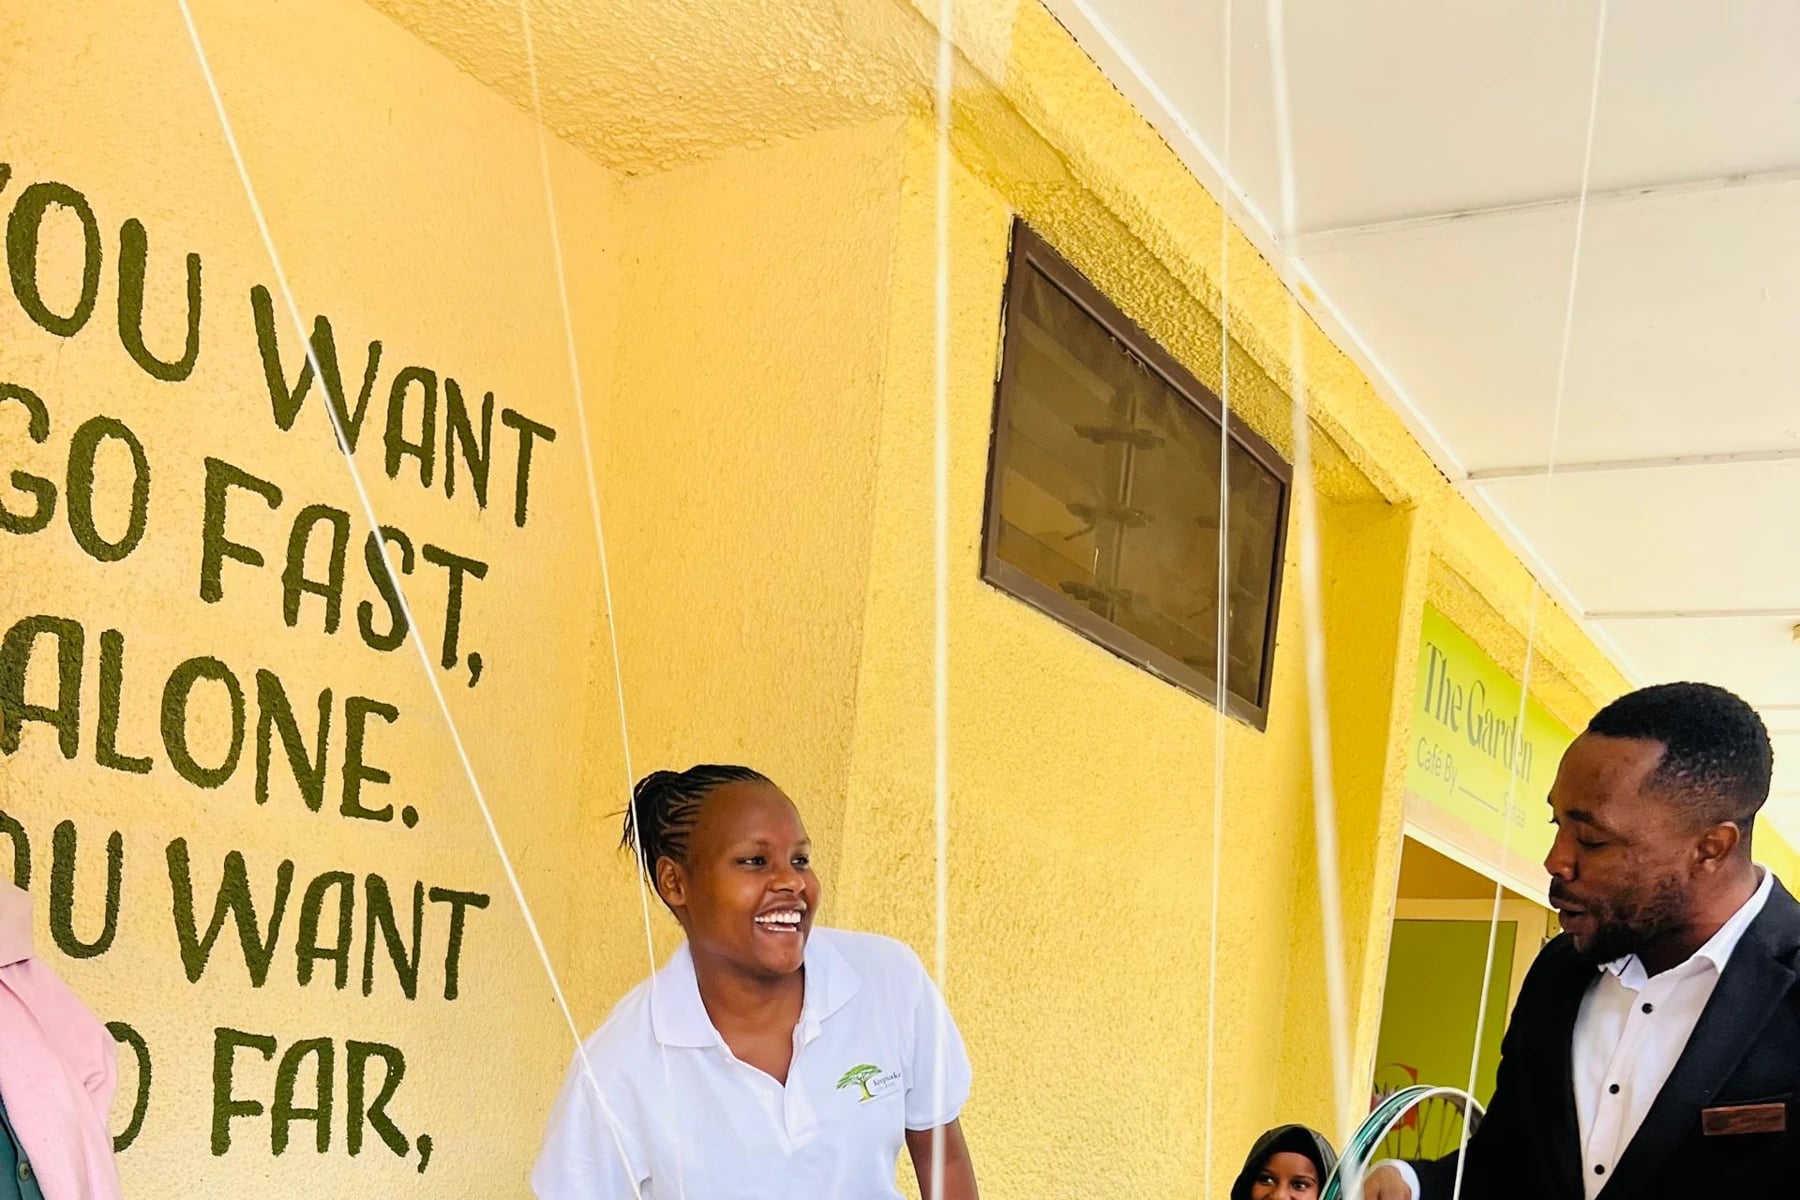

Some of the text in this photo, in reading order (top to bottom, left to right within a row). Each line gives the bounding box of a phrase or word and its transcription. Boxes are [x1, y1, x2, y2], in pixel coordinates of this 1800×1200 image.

[0, 162, 557, 528] OU WANT
[199, 456, 489, 689] FAST,
[0, 614, 419, 830] ALONE.
[1423, 641, 1533, 784] The Garden
[1444, 753, 1459, 795] By
[166, 837, 491, 1002] WANT
[210, 1026, 434, 1175] FAR,
